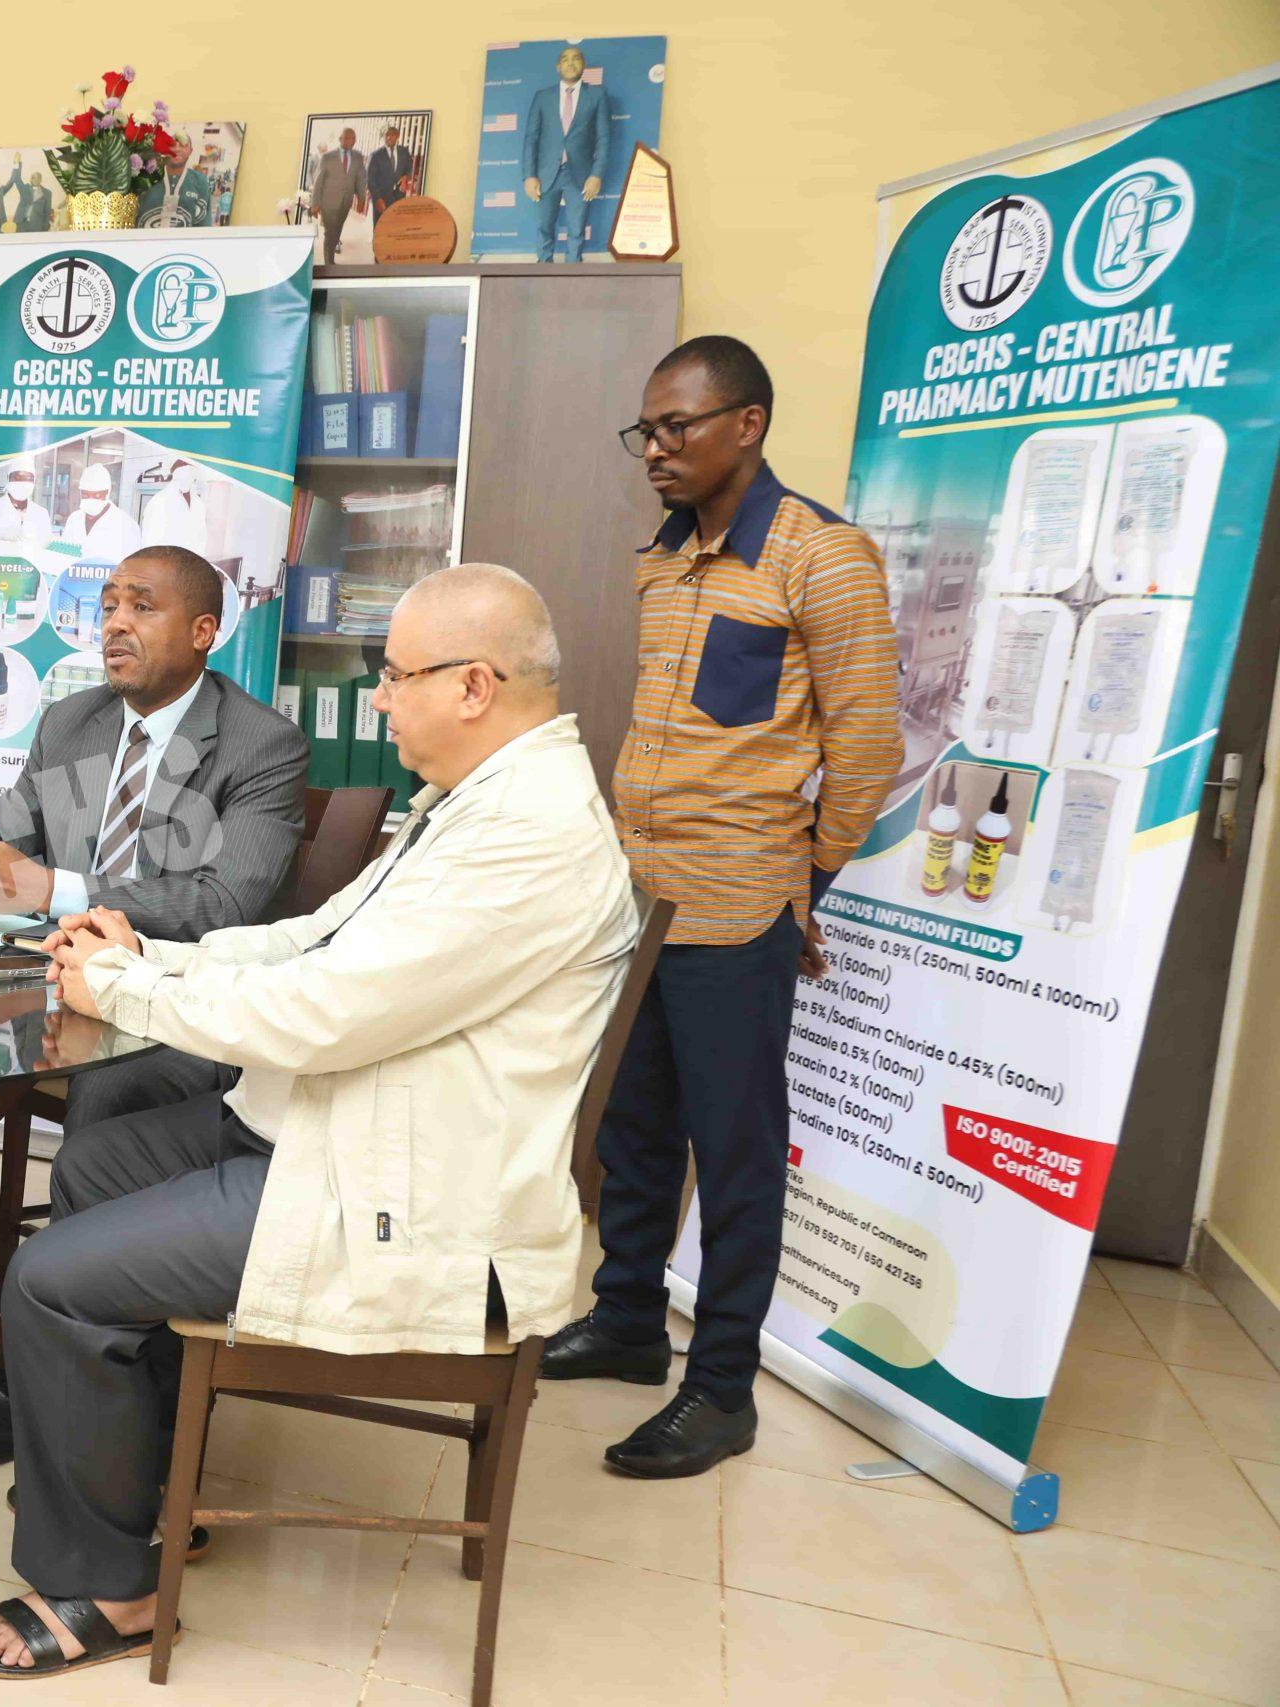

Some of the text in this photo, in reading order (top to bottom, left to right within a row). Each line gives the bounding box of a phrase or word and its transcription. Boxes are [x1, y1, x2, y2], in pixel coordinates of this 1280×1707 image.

[1008, 218, 1033, 260] SERVICES
[24, 287, 37, 335] CAMEROON
[94, 278, 112, 334] CONVENTION
[36, 275, 101, 308] HEALTH SERVICES
[51, 341, 76, 351] 1975
[923, 332, 1016, 382] CBCHS
[1035, 303, 1177, 365] CENTRAL
[968, 312, 998, 329] 1975
[13, 358, 93, 386] CBCHS
[113, 358, 223, 386] CENTRAL
[878, 343, 1233, 426] PHARMACY MUTENGENE
[111, 389, 260, 417] MUTENGENE
[820, 893, 1015, 957] VENOUS INFUSION FLUIDS
[824, 924, 875, 950] Chloride
[880, 940, 911, 961] 0.9%
[975, 966, 1029, 995] 500ml
[1031, 983, 1043, 998] &
[1046, 986, 1121, 1022] 1000ml)
[840, 951, 891, 986] (500ml)
[841, 981, 890, 1014] (100ml)
[788, 1052, 827, 1076] oxacin
[862, 1075, 913, 1112] (100ml)
[790, 1024, 924, 1086] nidazole 0.5% (100ml)
[884, 1029, 944, 1061] Chloride
[948, 1051, 993, 1079] 0.45%
[998, 1064, 1064, 1106] (500ml)
[792, 1078, 892, 1134] Lactate (500ml)
[836, 1126, 860, 1147] 10%
[862, 1134, 910, 1175] (250ml
[913, 1161, 923, 1176] &
[926, 1166, 984, 1204] 500ml)
[956, 1115, 1081, 1176] ISO 9001: 2015
[993, 1152, 1077, 1198] Certified
[804, 1220, 820, 1236] 679
[822, 1229, 839, 1246] 592
[840, 1238, 858, 1255] 705
[884, 1263, 903, 1279] 421
[816, 1198, 858, 1226] Republic
[860, 1221, 871, 1232] of
[871, 1225, 928, 1262] Cameroon
[779, 1244, 860, 1296] ealthservices.org
